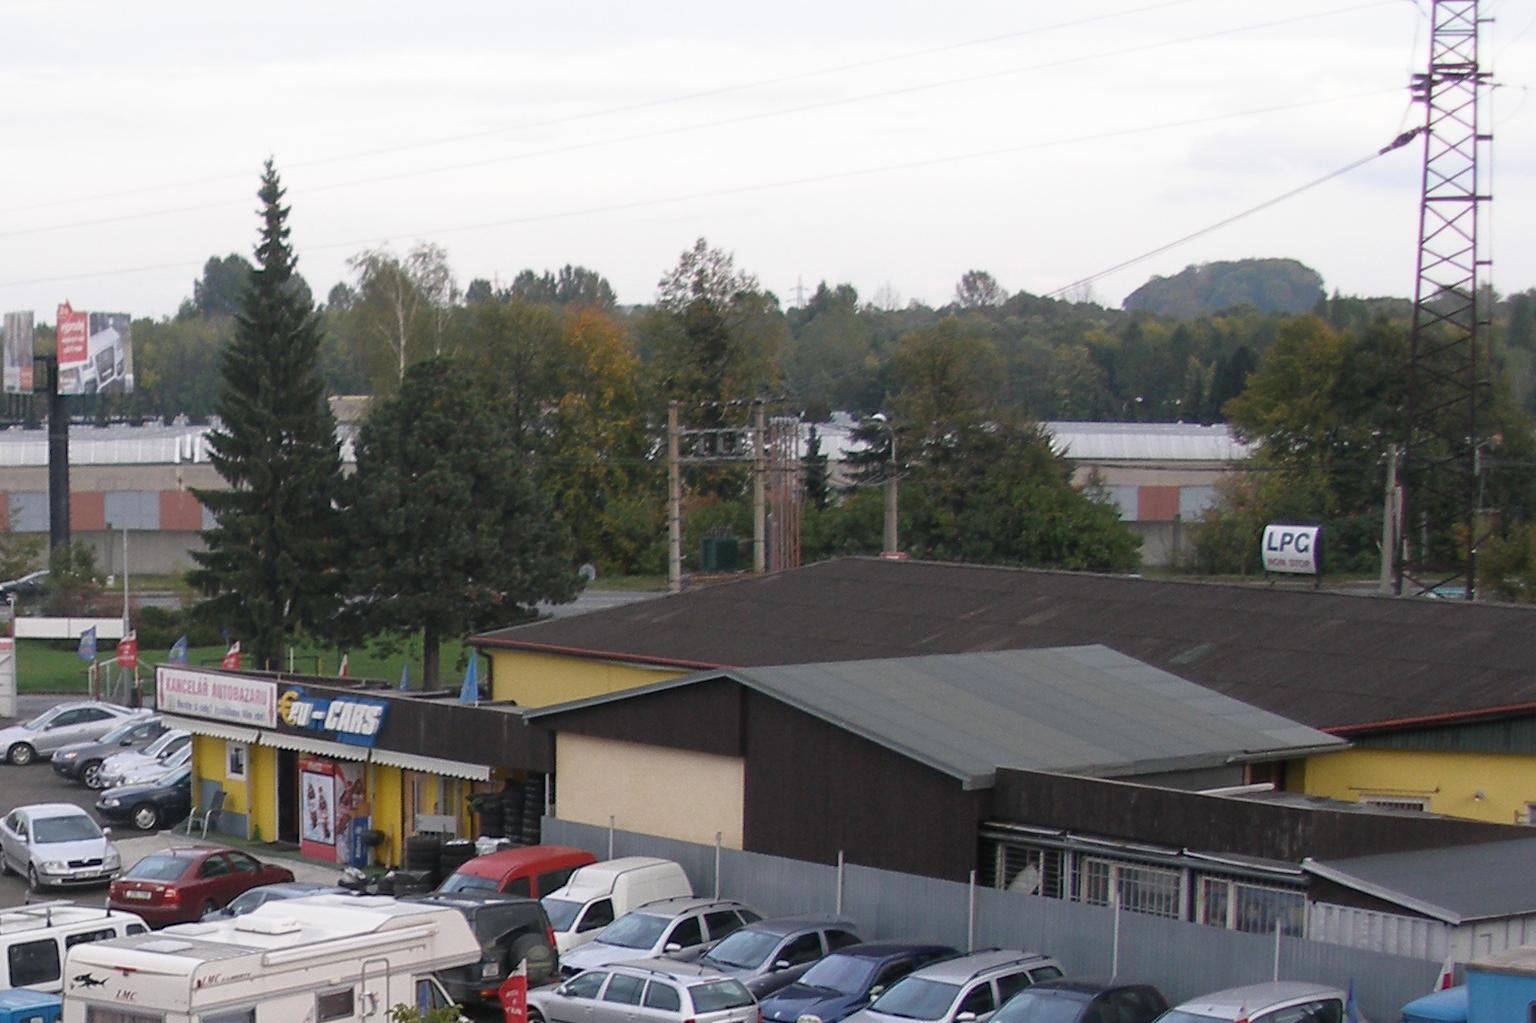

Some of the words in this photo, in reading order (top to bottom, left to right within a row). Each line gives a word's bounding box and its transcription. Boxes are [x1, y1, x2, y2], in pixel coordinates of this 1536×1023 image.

[1267, 532, 1310, 553] LPG
[165, 677, 208, 697] KANCELÁŘ
[211, 682, 267, 706] AUTOBAZARU
[201, 973, 222, 986] LMC
[116, 989, 137, 1000] LMC
